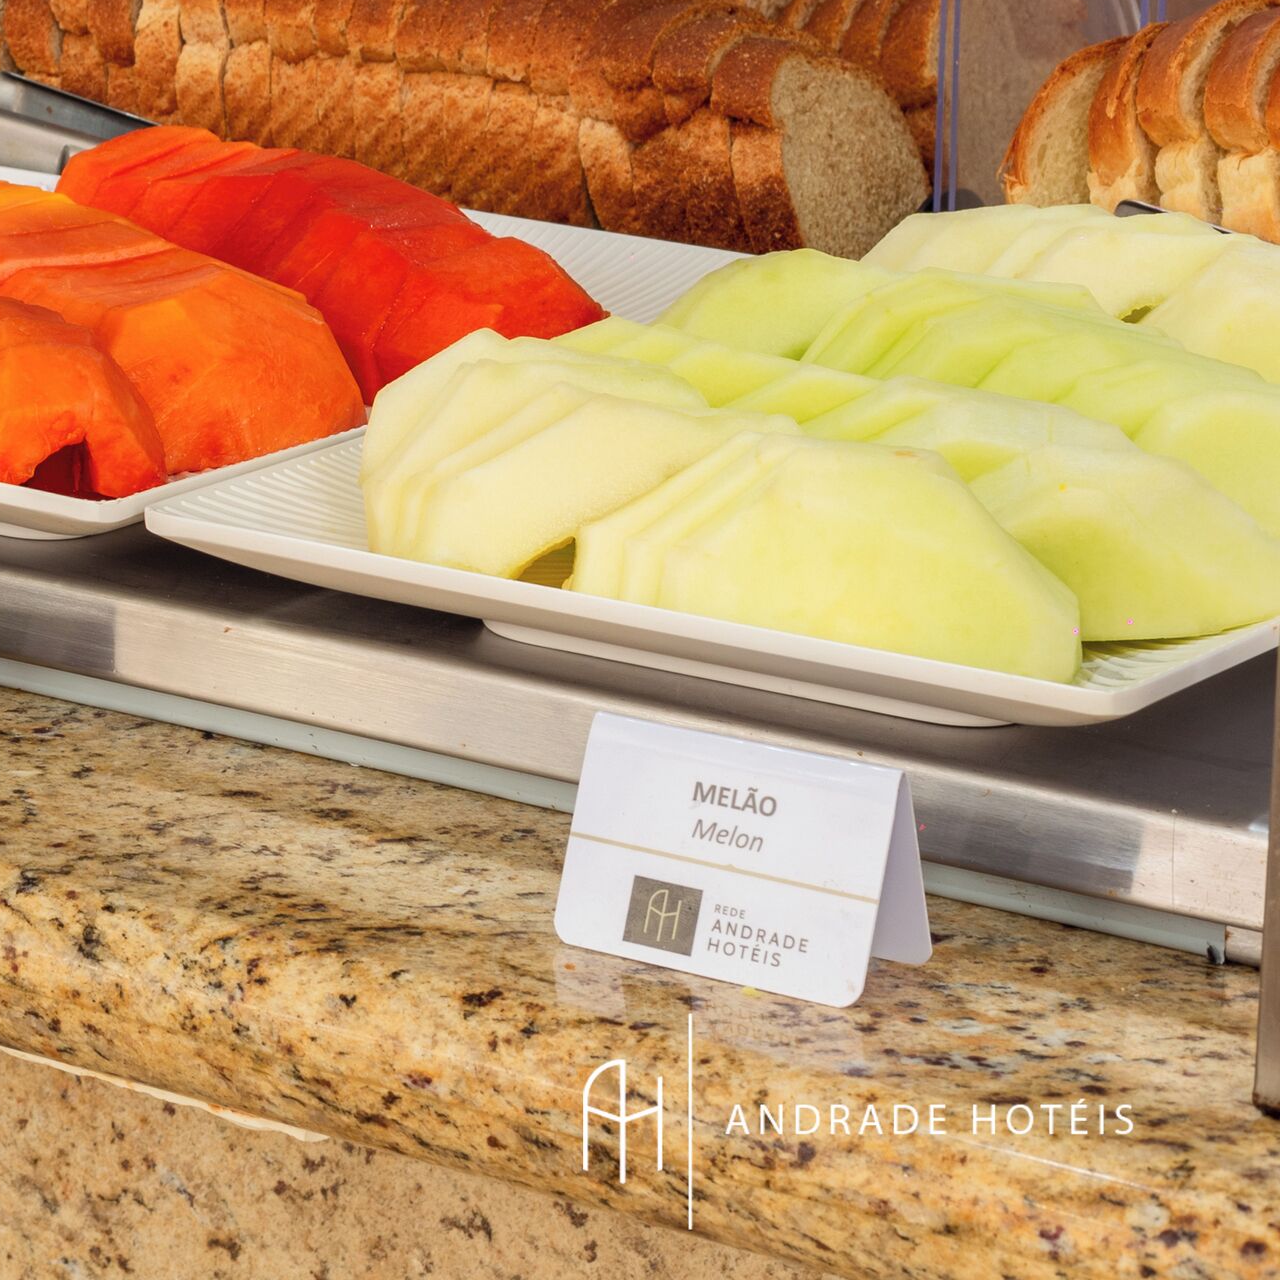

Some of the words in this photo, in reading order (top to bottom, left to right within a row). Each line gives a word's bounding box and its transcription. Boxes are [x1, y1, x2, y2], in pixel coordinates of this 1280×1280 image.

[691, 780, 778, 817] MELÃO
[691, 818, 765, 853] Melon
[713, 903, 747, 920] REDE
[706, 938, 783, 968] HOTÉIS
[711, 918, 810, 954] ANDRADE
